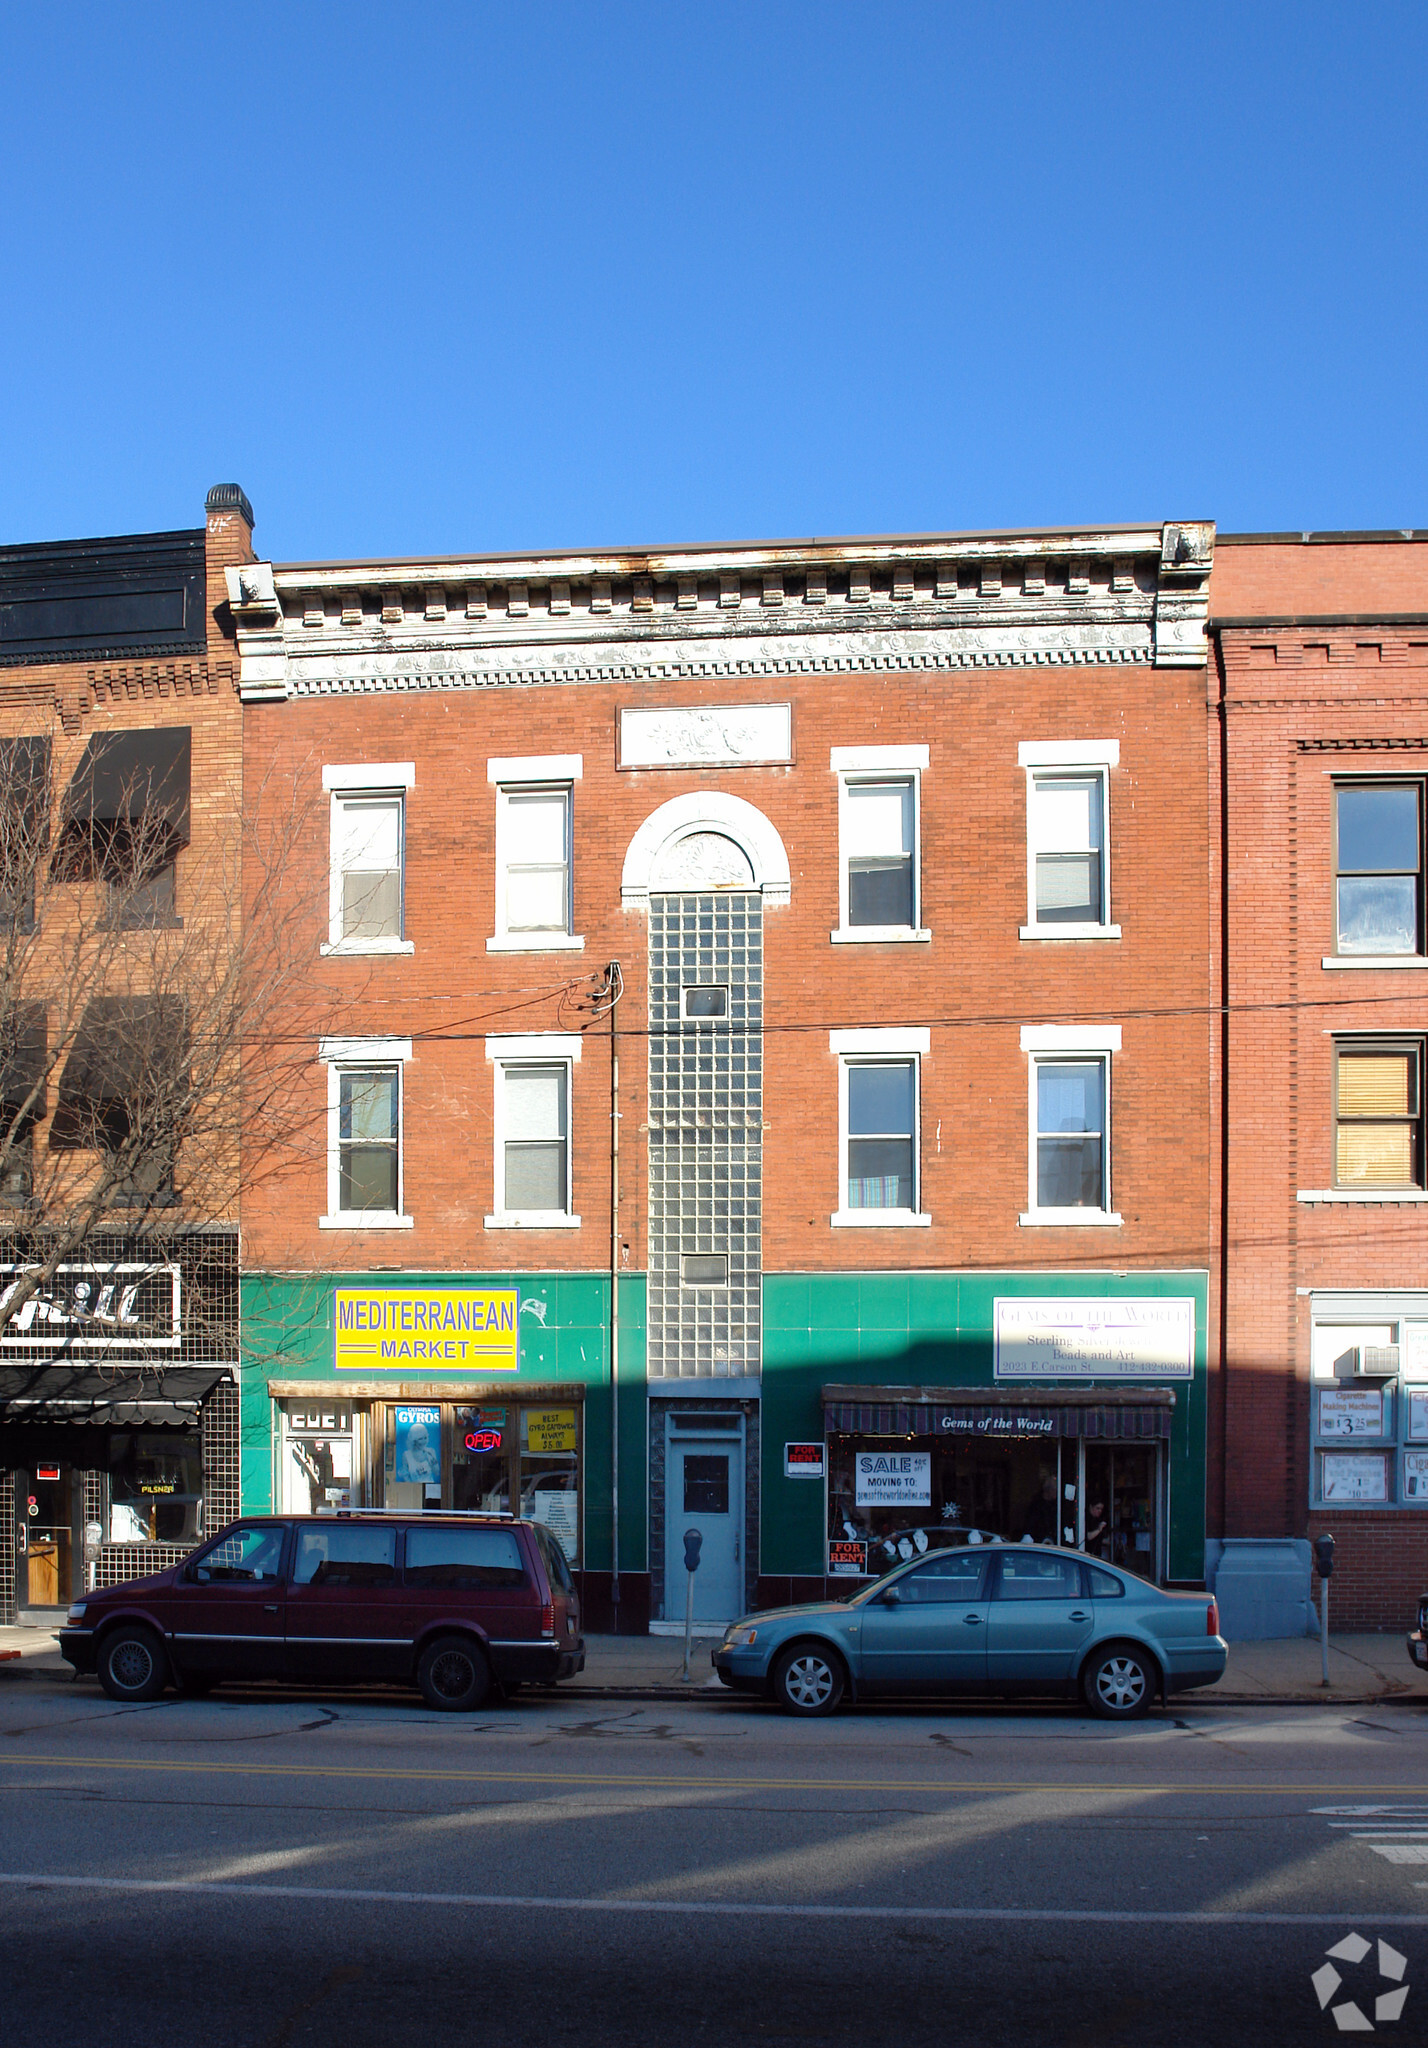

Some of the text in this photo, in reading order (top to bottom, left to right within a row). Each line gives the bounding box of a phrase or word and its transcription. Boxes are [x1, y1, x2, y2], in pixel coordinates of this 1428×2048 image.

[339, 1300, 513, 1331] MEDITERRANEAN
[1027, 1335, 1073, 1348] Sterling
[381, 1340, 470, 1359] MARKET
[1053, 1349, 1136, 1360] Beads and Art
[1003, 1362, 1027, 1372] 2023
[1080, 1362, 1095, 1373] St.
[1117, 1362, 1186, 1373] 412-432-0300
[291, 1404, 347, 1429] 2021
[398, 1411, 440, 1424] GYROS
[542, 1414, 559, 1423] BEST
[941, 1416, 1054, 1431] Gems of the World
[464, 1433, 502, 1448] OPEN
[794, 1446, 816, 1454] FOR
[789, 1454, 822, 1462] RENT
[860, 1457, 911, 1474] SALE
[868, 1477, 901, 1487] MOVING
[141, 1485, 174, 1494] PILSNER
[835, 1543, 861, 1553] FOR
[830, 1553, 866, 1564] RENT
